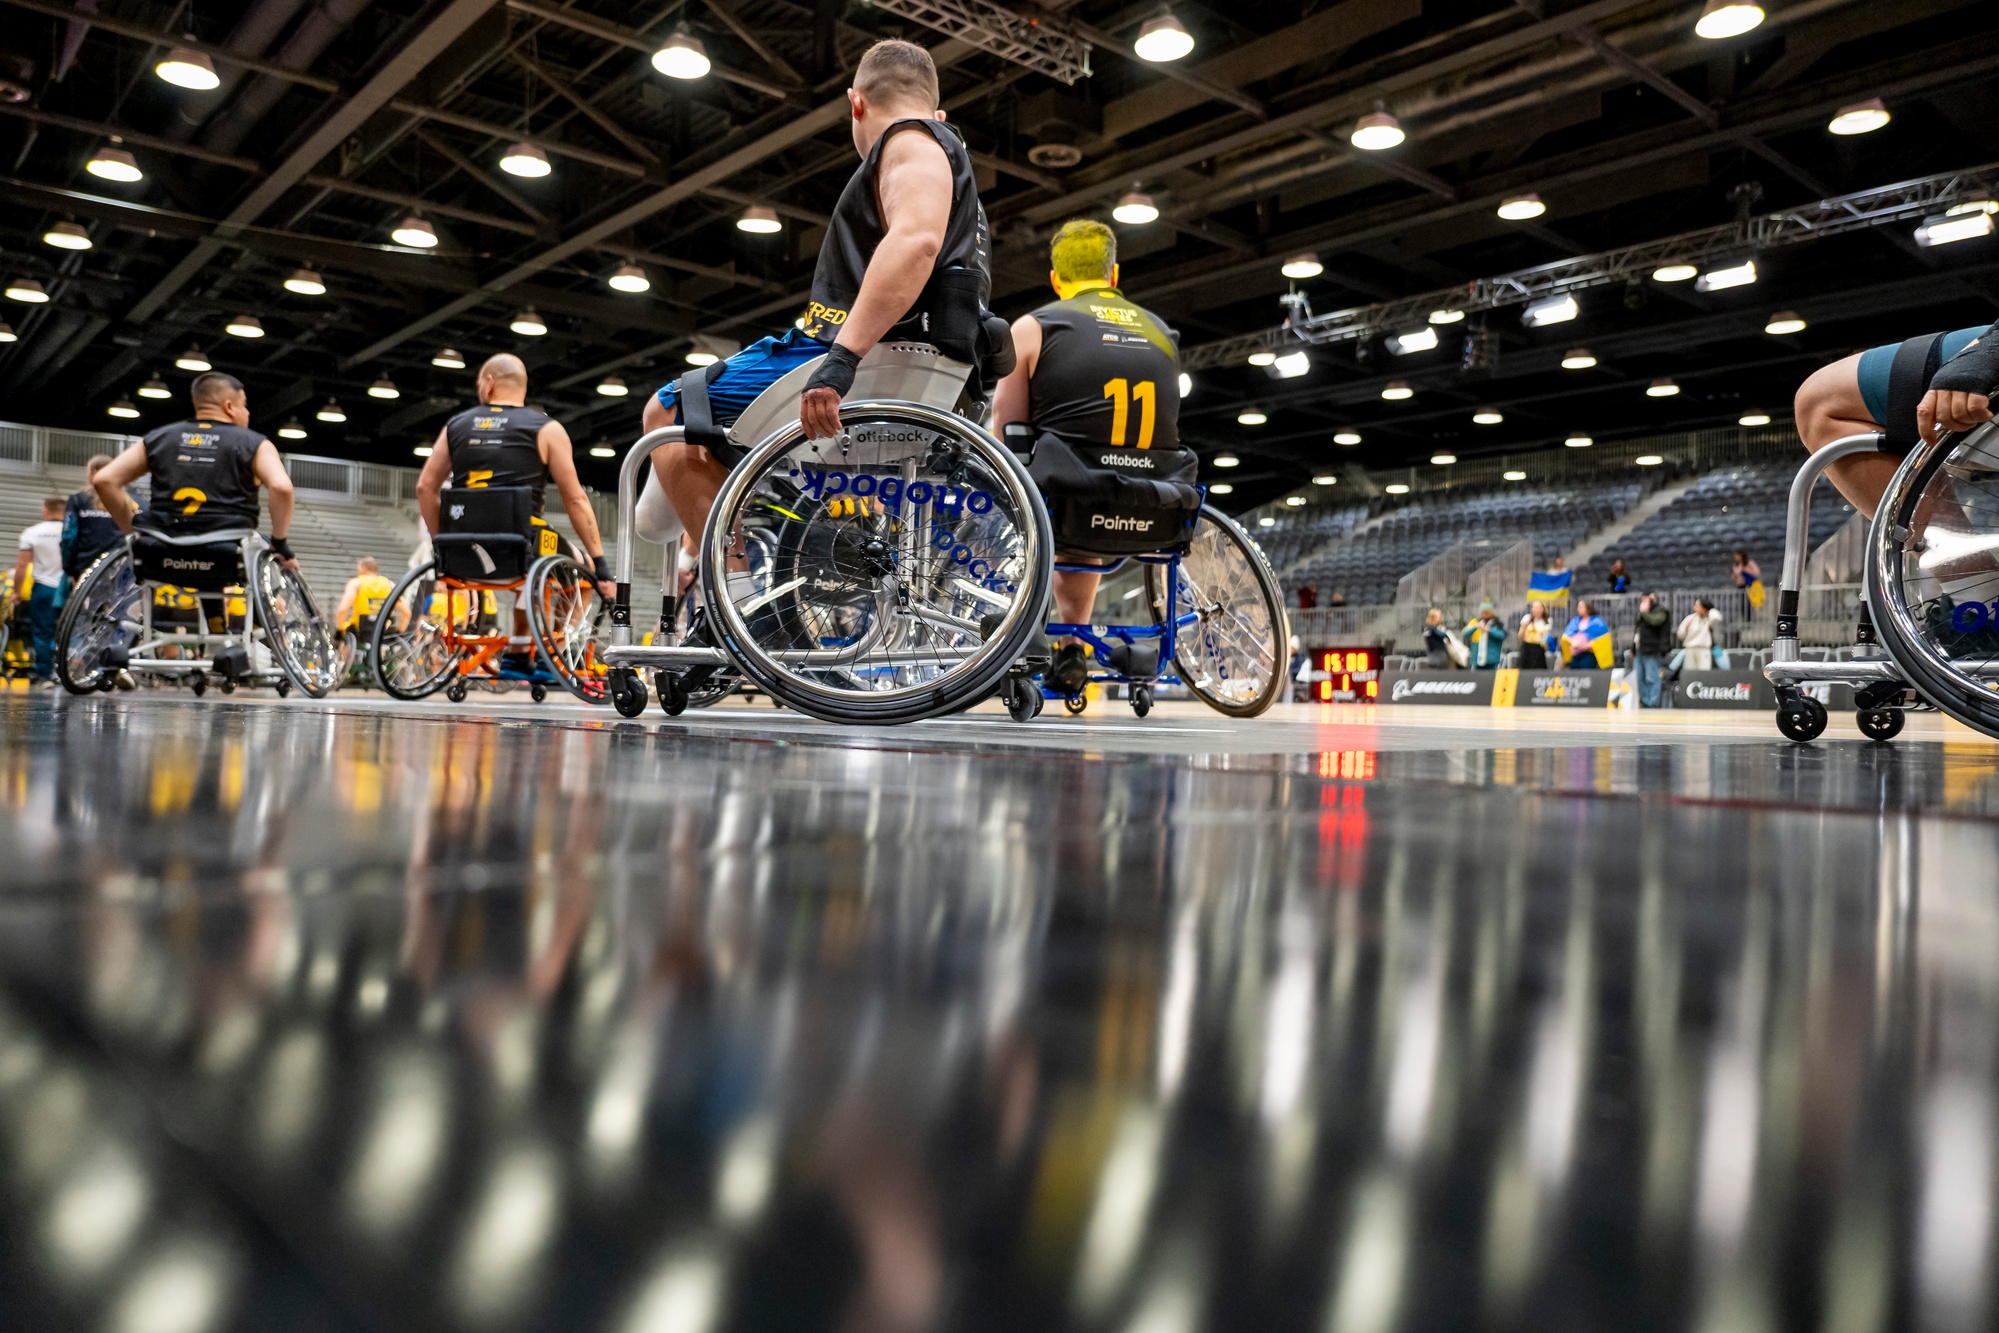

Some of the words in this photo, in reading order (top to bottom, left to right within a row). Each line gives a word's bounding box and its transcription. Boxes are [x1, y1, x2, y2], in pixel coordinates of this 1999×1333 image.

[1103, 377, 1155, 450] 11
[1101, 454, 1155, 469] ottobock.
[790, 468, 993, 522] ottobock.
[1091, 514, 1154, 532] Pointer
[543, 534, 557, 551] 80
[163, 558, 215, 571] Pointer
[1320, 680, 1332, 700] 0
[1411, 681, 1477, 694] BOEING
[1533, 676, 1592, 689] INVICTUS
[1686, 681, 1751, 701] Canada
